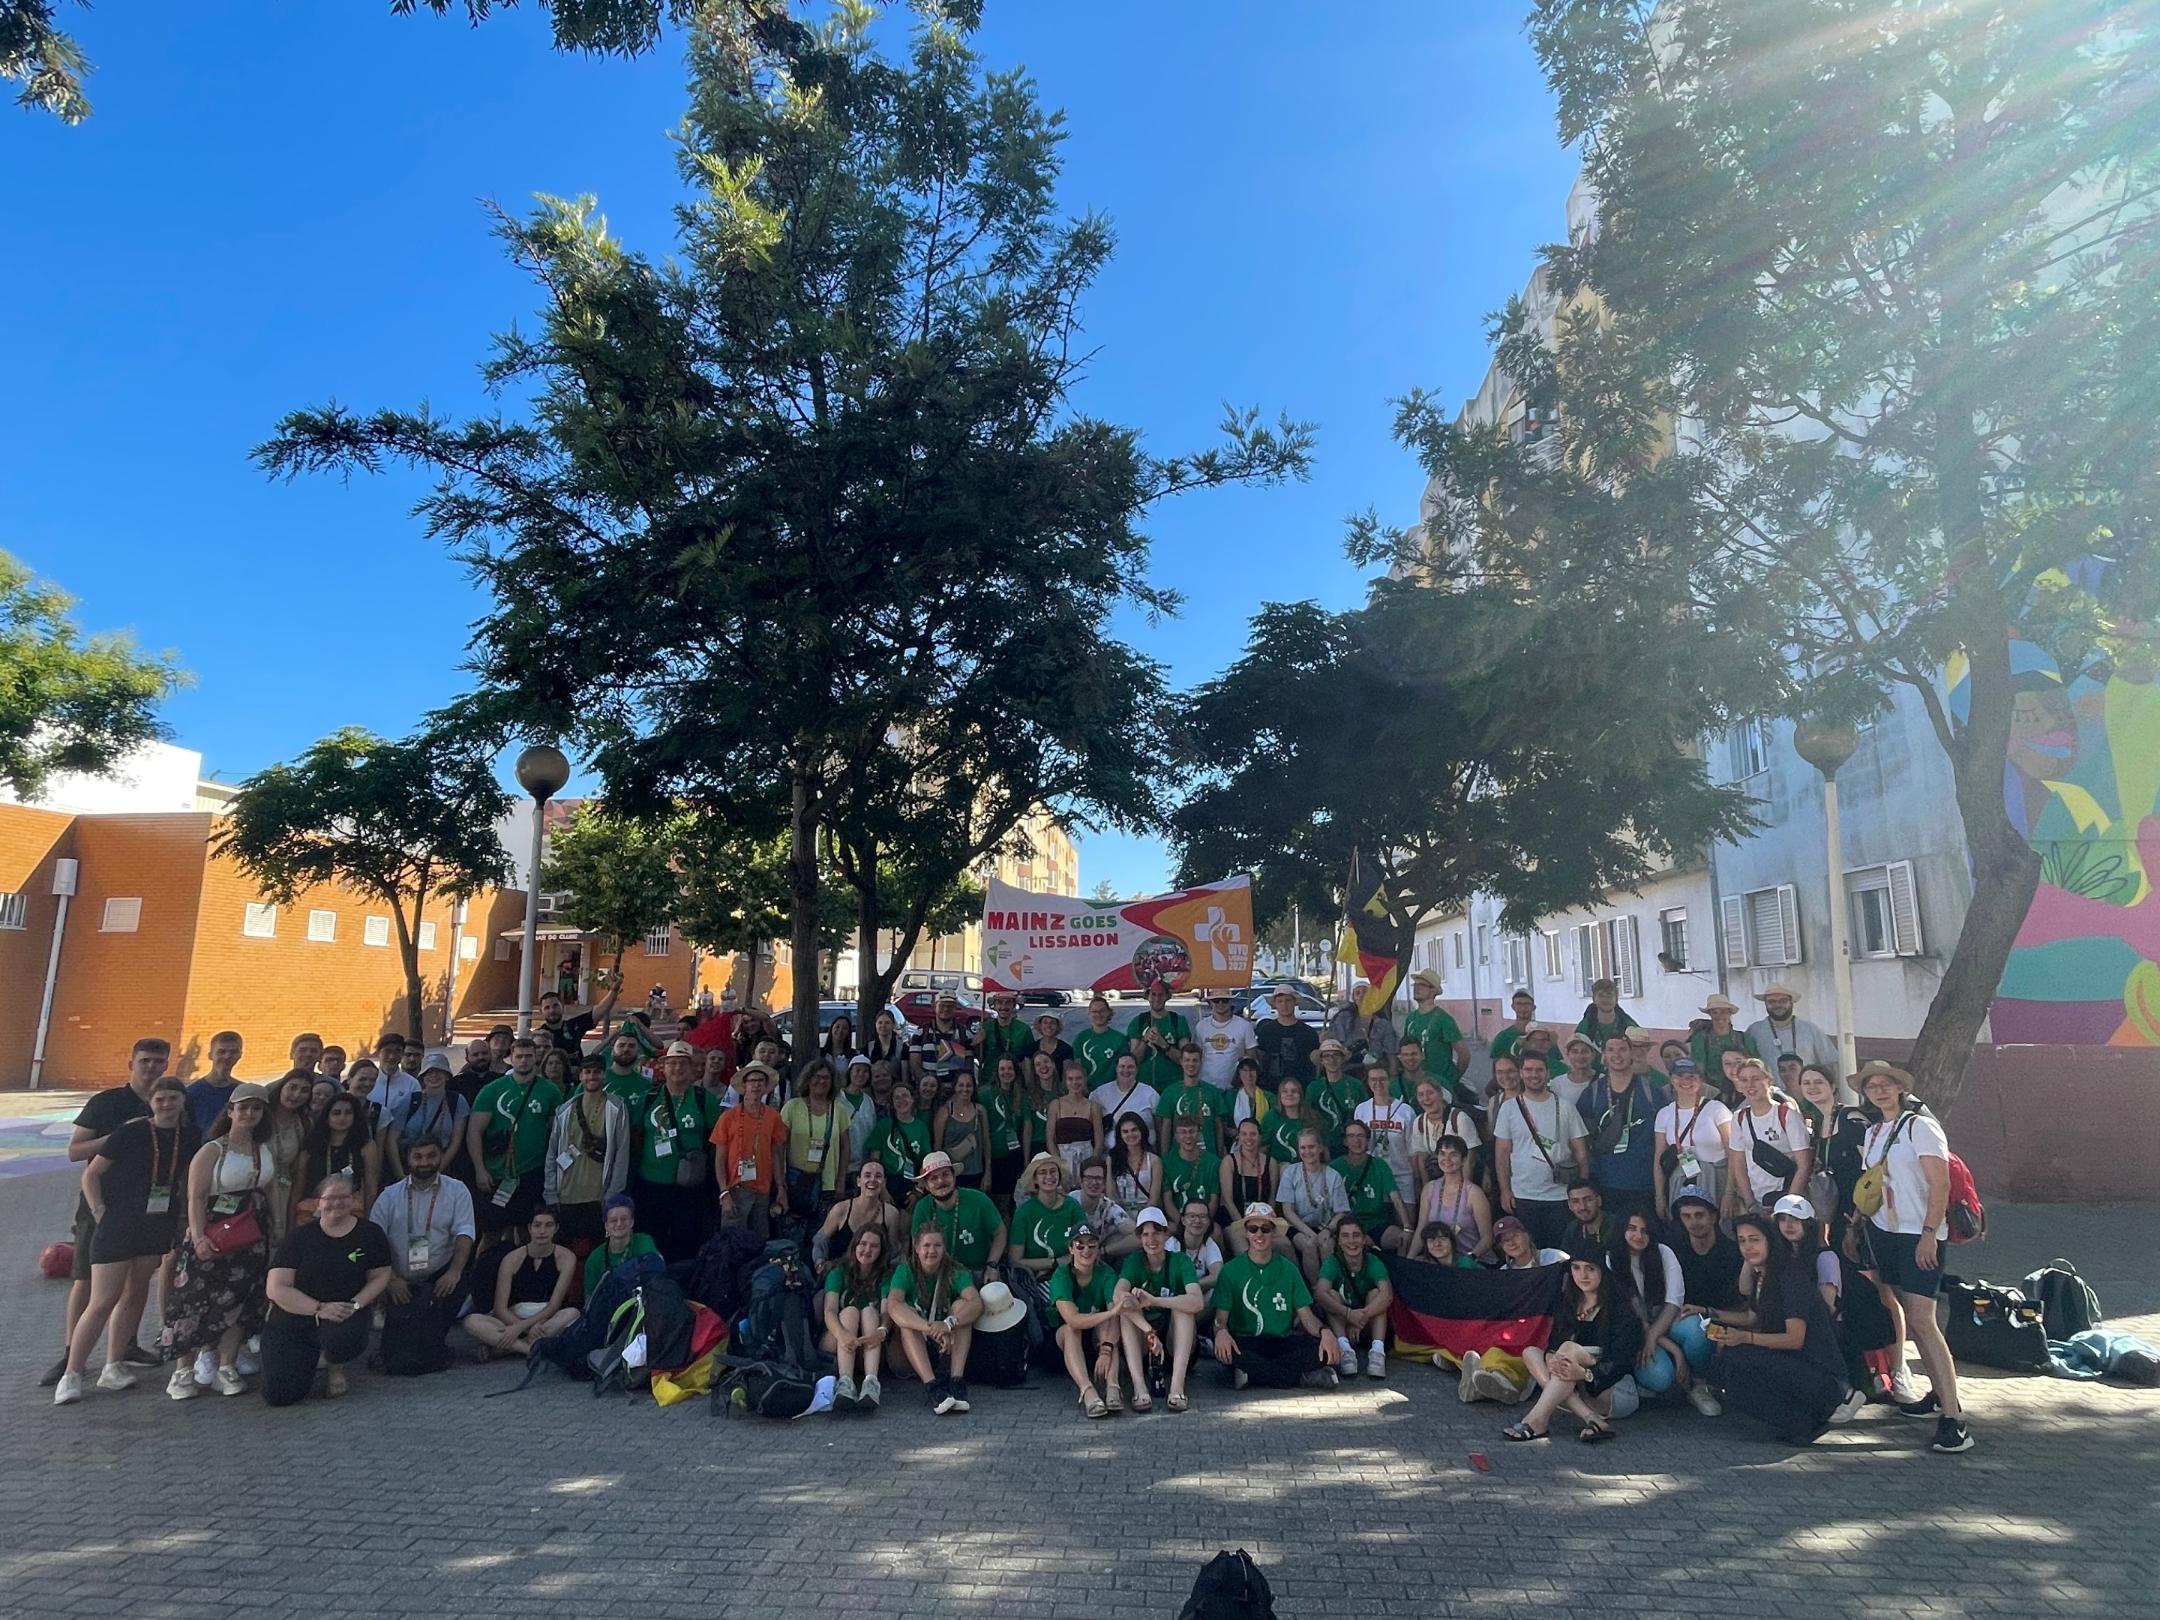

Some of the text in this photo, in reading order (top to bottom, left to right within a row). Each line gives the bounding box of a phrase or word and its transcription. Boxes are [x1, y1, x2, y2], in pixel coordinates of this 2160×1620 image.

[988, 912, 1117, 930] MAINZ GOES
[1029, 933, 1119, 948] LISSABON
